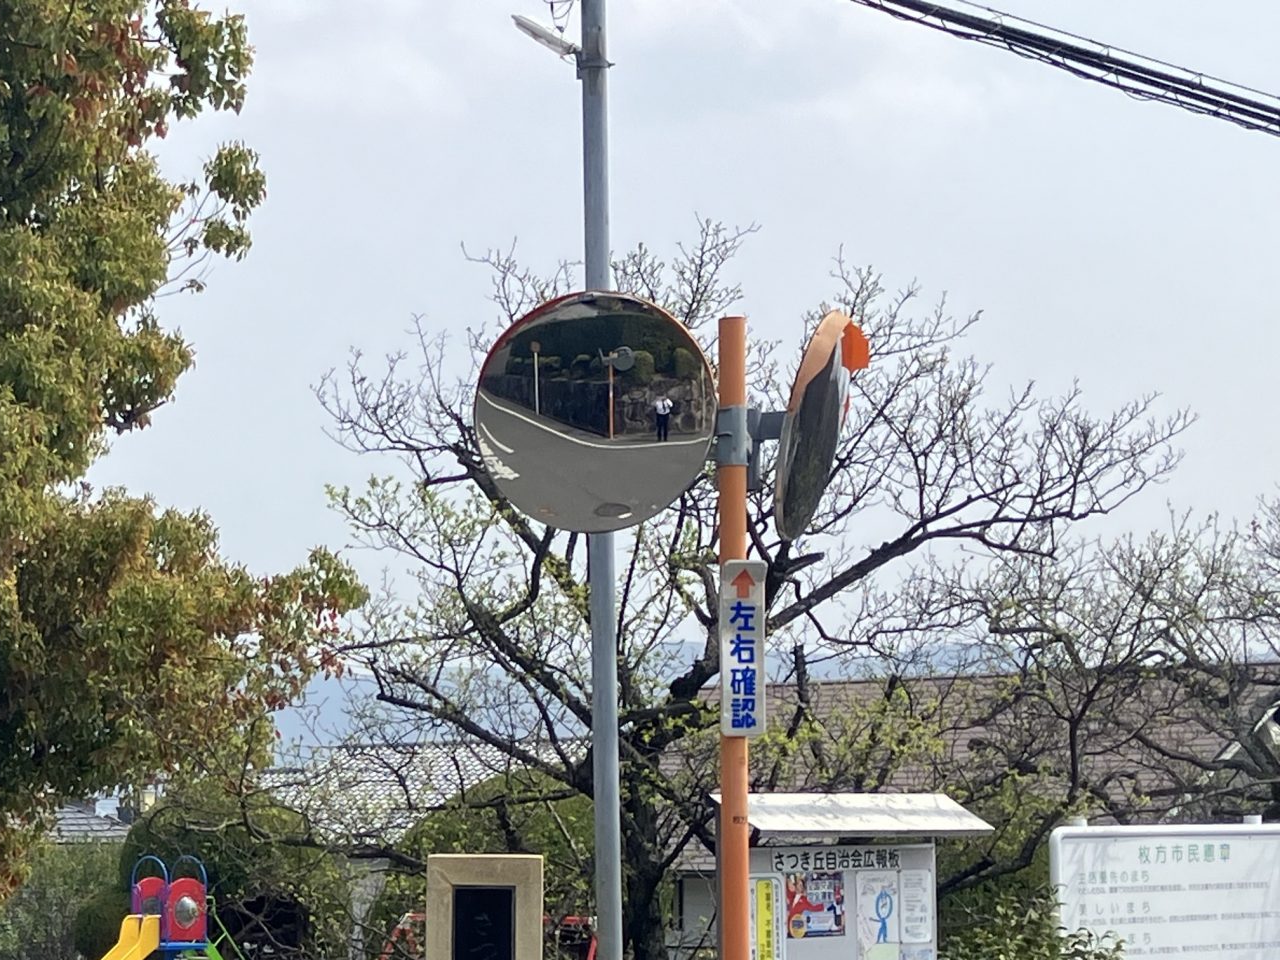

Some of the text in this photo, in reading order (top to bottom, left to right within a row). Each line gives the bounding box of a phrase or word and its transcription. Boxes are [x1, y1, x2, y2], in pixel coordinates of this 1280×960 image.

[729, 601, 757, 729] 左右確認
[774, 849, 900, 871] さつき丘自治会広報板
